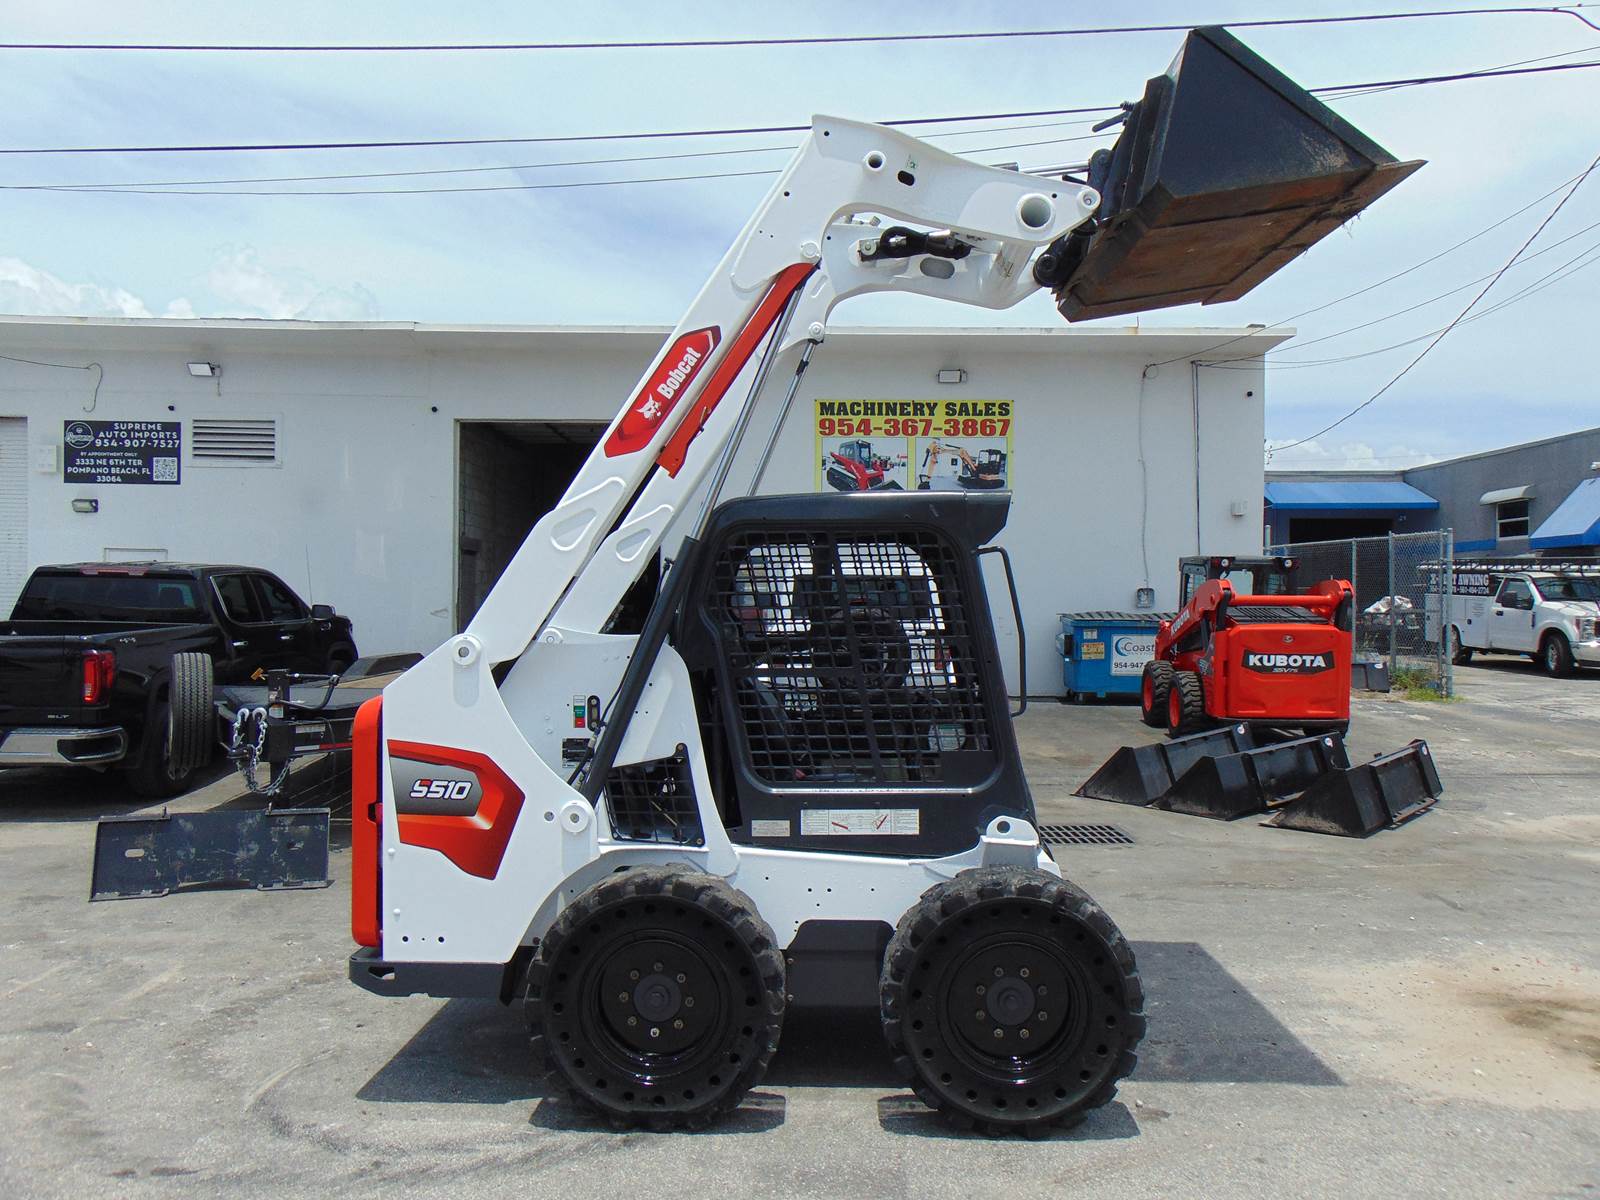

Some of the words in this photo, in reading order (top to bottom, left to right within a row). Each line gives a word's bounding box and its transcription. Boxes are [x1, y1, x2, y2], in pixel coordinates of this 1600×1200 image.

[657, 346, 702, 400] Bobcat
[819, 401, 938, 416] MACHINERY
[945, 402, 1010, 416] SALES
[818, 418, 1010, 437] 954-367-3867
[131, 431, 178, 439] IMPORTS
[95, 439, 180, 448] 954-907-7527
[111, 467, 140, 475] BEACH,
[1458, 574, 1489, 586] AWNING
[1248, 654, 1326, 667] KUBOTA
[410, 778, 473, 800] S510
